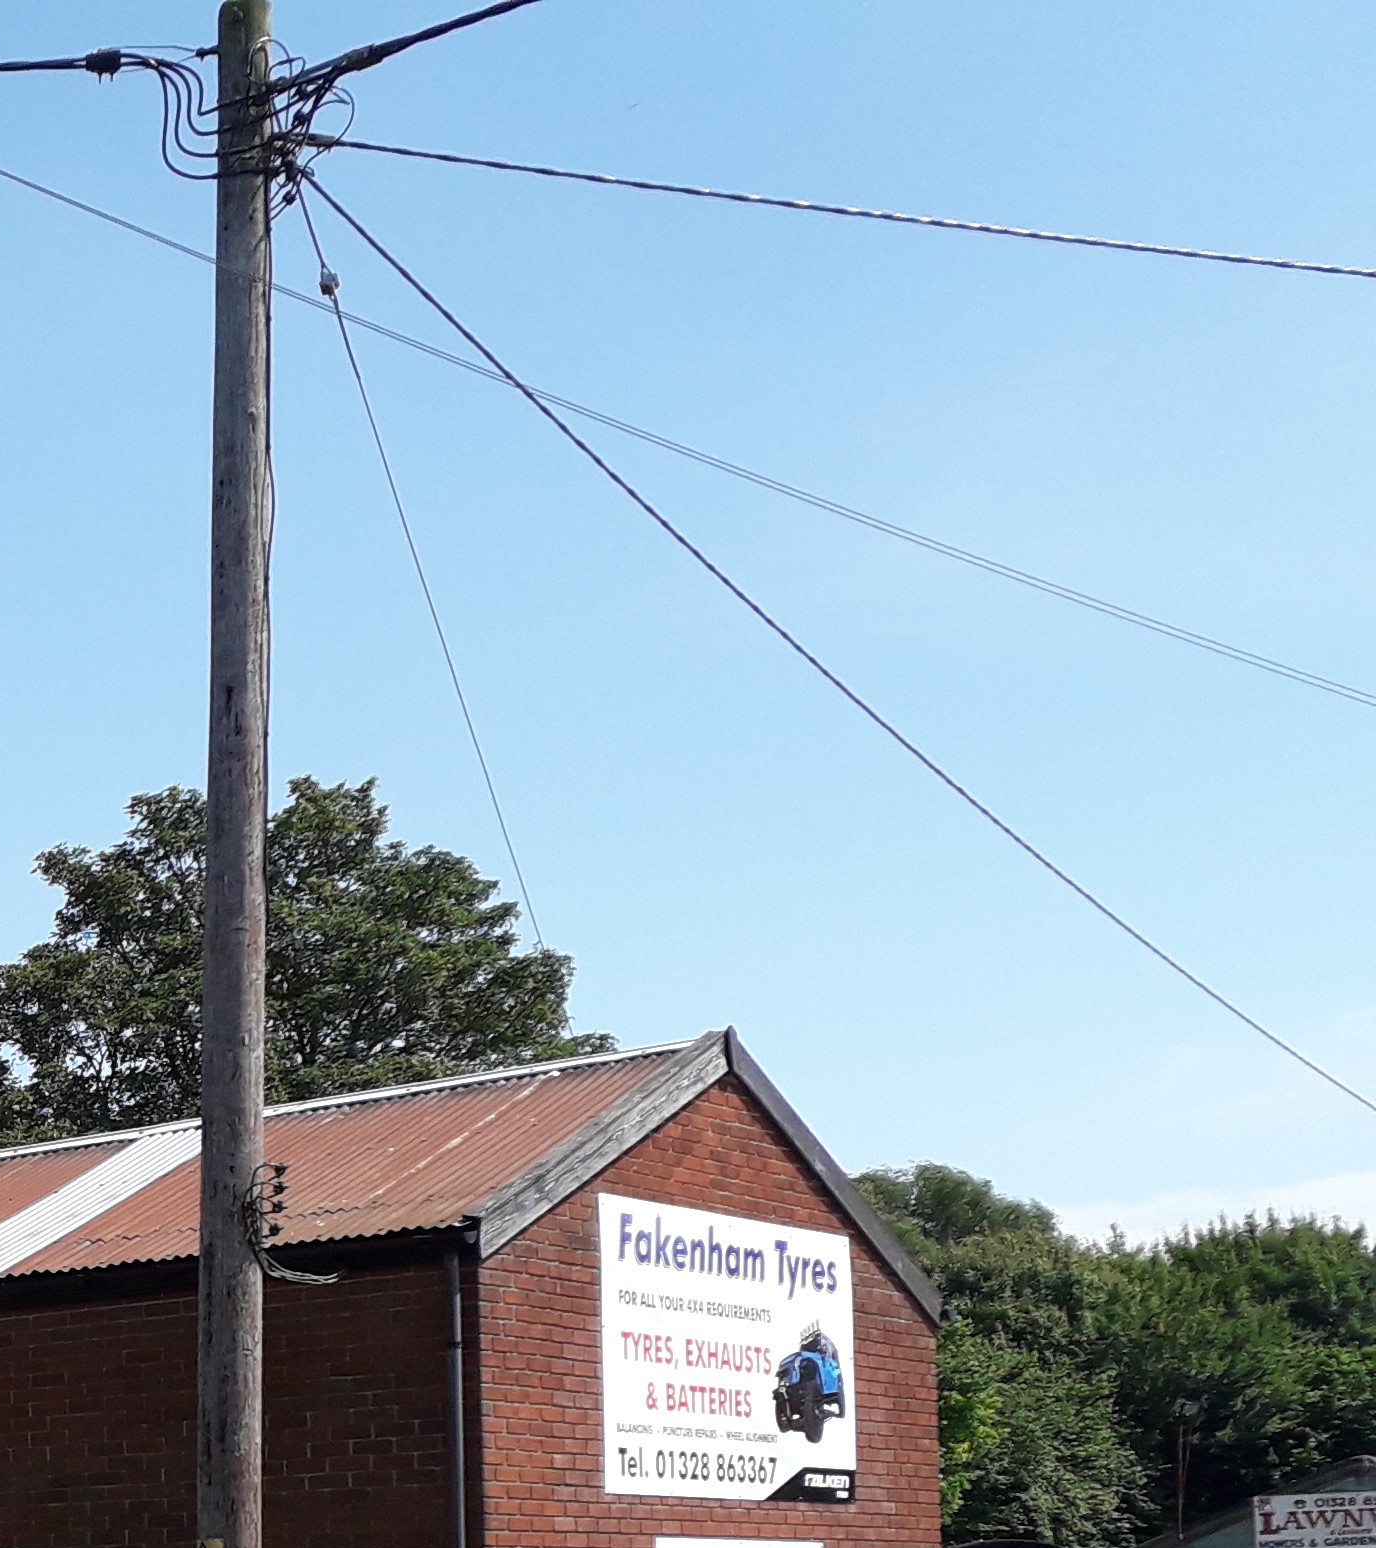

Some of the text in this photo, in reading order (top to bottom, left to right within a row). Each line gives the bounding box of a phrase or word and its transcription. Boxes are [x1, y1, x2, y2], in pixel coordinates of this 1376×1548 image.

[618, 1213, 838, 1300] Fakenham Tyres
[618, 1289, 637, 1306] FOR
[640, 1293, 656, 1309] ALL
[659, 1295, 684, 1313] YOUR
[707, 1301, 771, 1324] REQUIREMENTS
[621, 1331, 772, 1375] TYRES, EXHAUSTS
[646, 1381, 752, 1418] & BATTERIES
[618, 1447, 778, 1485] Tel. 01328 863367
[1314, 1496, 1357, 1508] 01328
